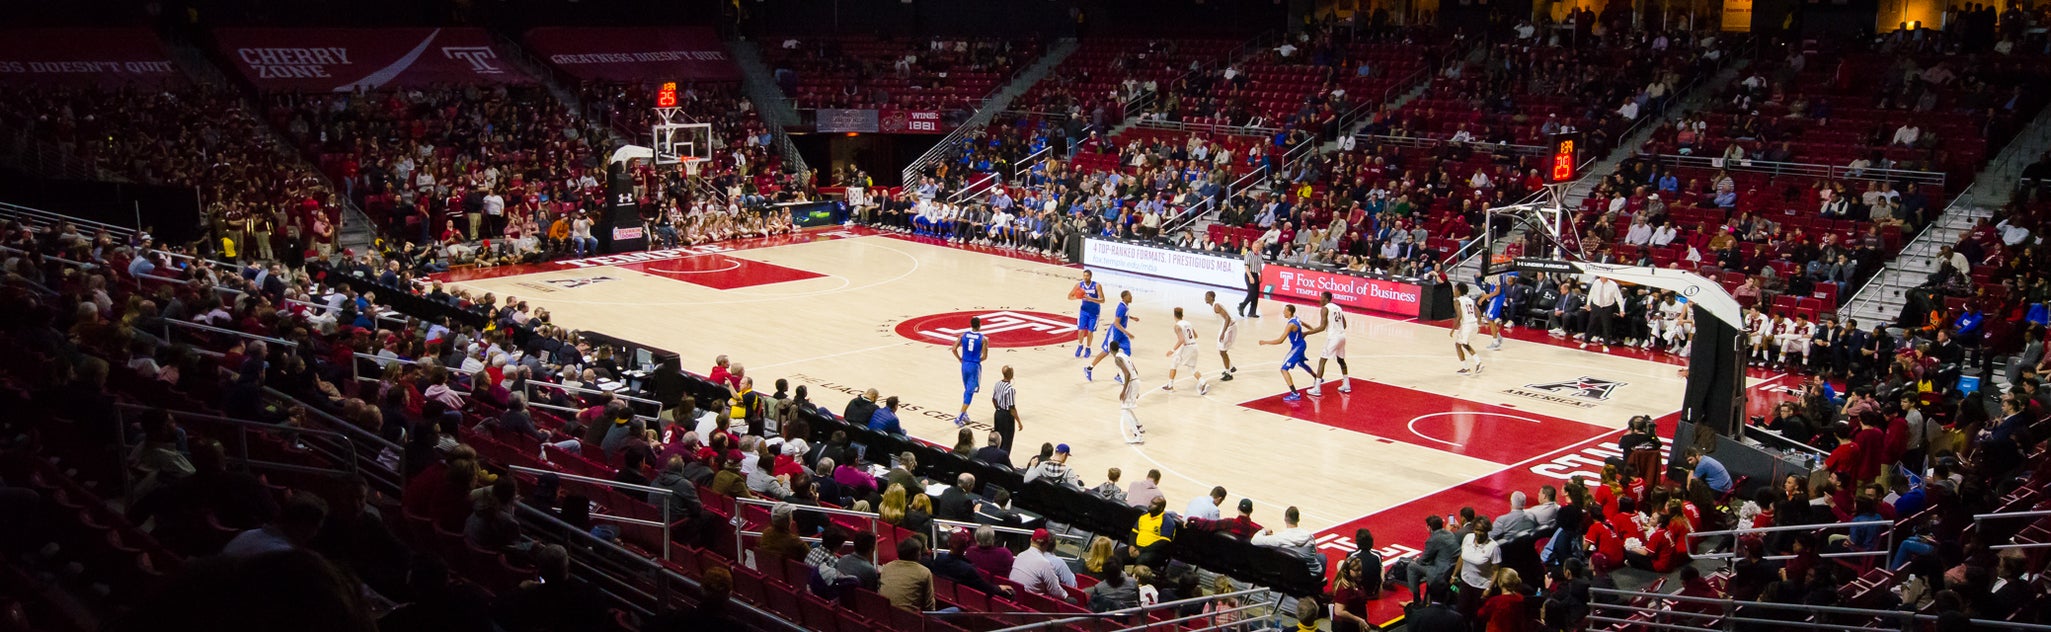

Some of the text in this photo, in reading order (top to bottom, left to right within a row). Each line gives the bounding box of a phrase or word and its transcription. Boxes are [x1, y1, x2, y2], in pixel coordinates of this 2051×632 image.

[238, 47, 352, 65] CHERRY
[550, 50, 727, 65] GREATNESS DOESN'T QUIT
[28, 61, 121, 73] DOESN'T
[124, 60, 175, 73] QUIT
[251, 65, 331, 78] ZONE
[660, 91, 675, 105] 25
[911, 112, 939, 120] WINS:
[908, 121, 936, 131] 1881
[1554, 155, 1570, 179] 25
[1099, 243, 1136, 259] TOP-RANKED
[1173, 255, 1215, 271] PRESTIGIOUS
[1296, 273, 1416, 303] Fox School of Business
[1296, 288, 1318, 297] TEMPLE
[1333, 311, 1342, 323] 24
[1501, 388, 1599, 408] AMERICAN
[662, 430, 673, 445] 2
